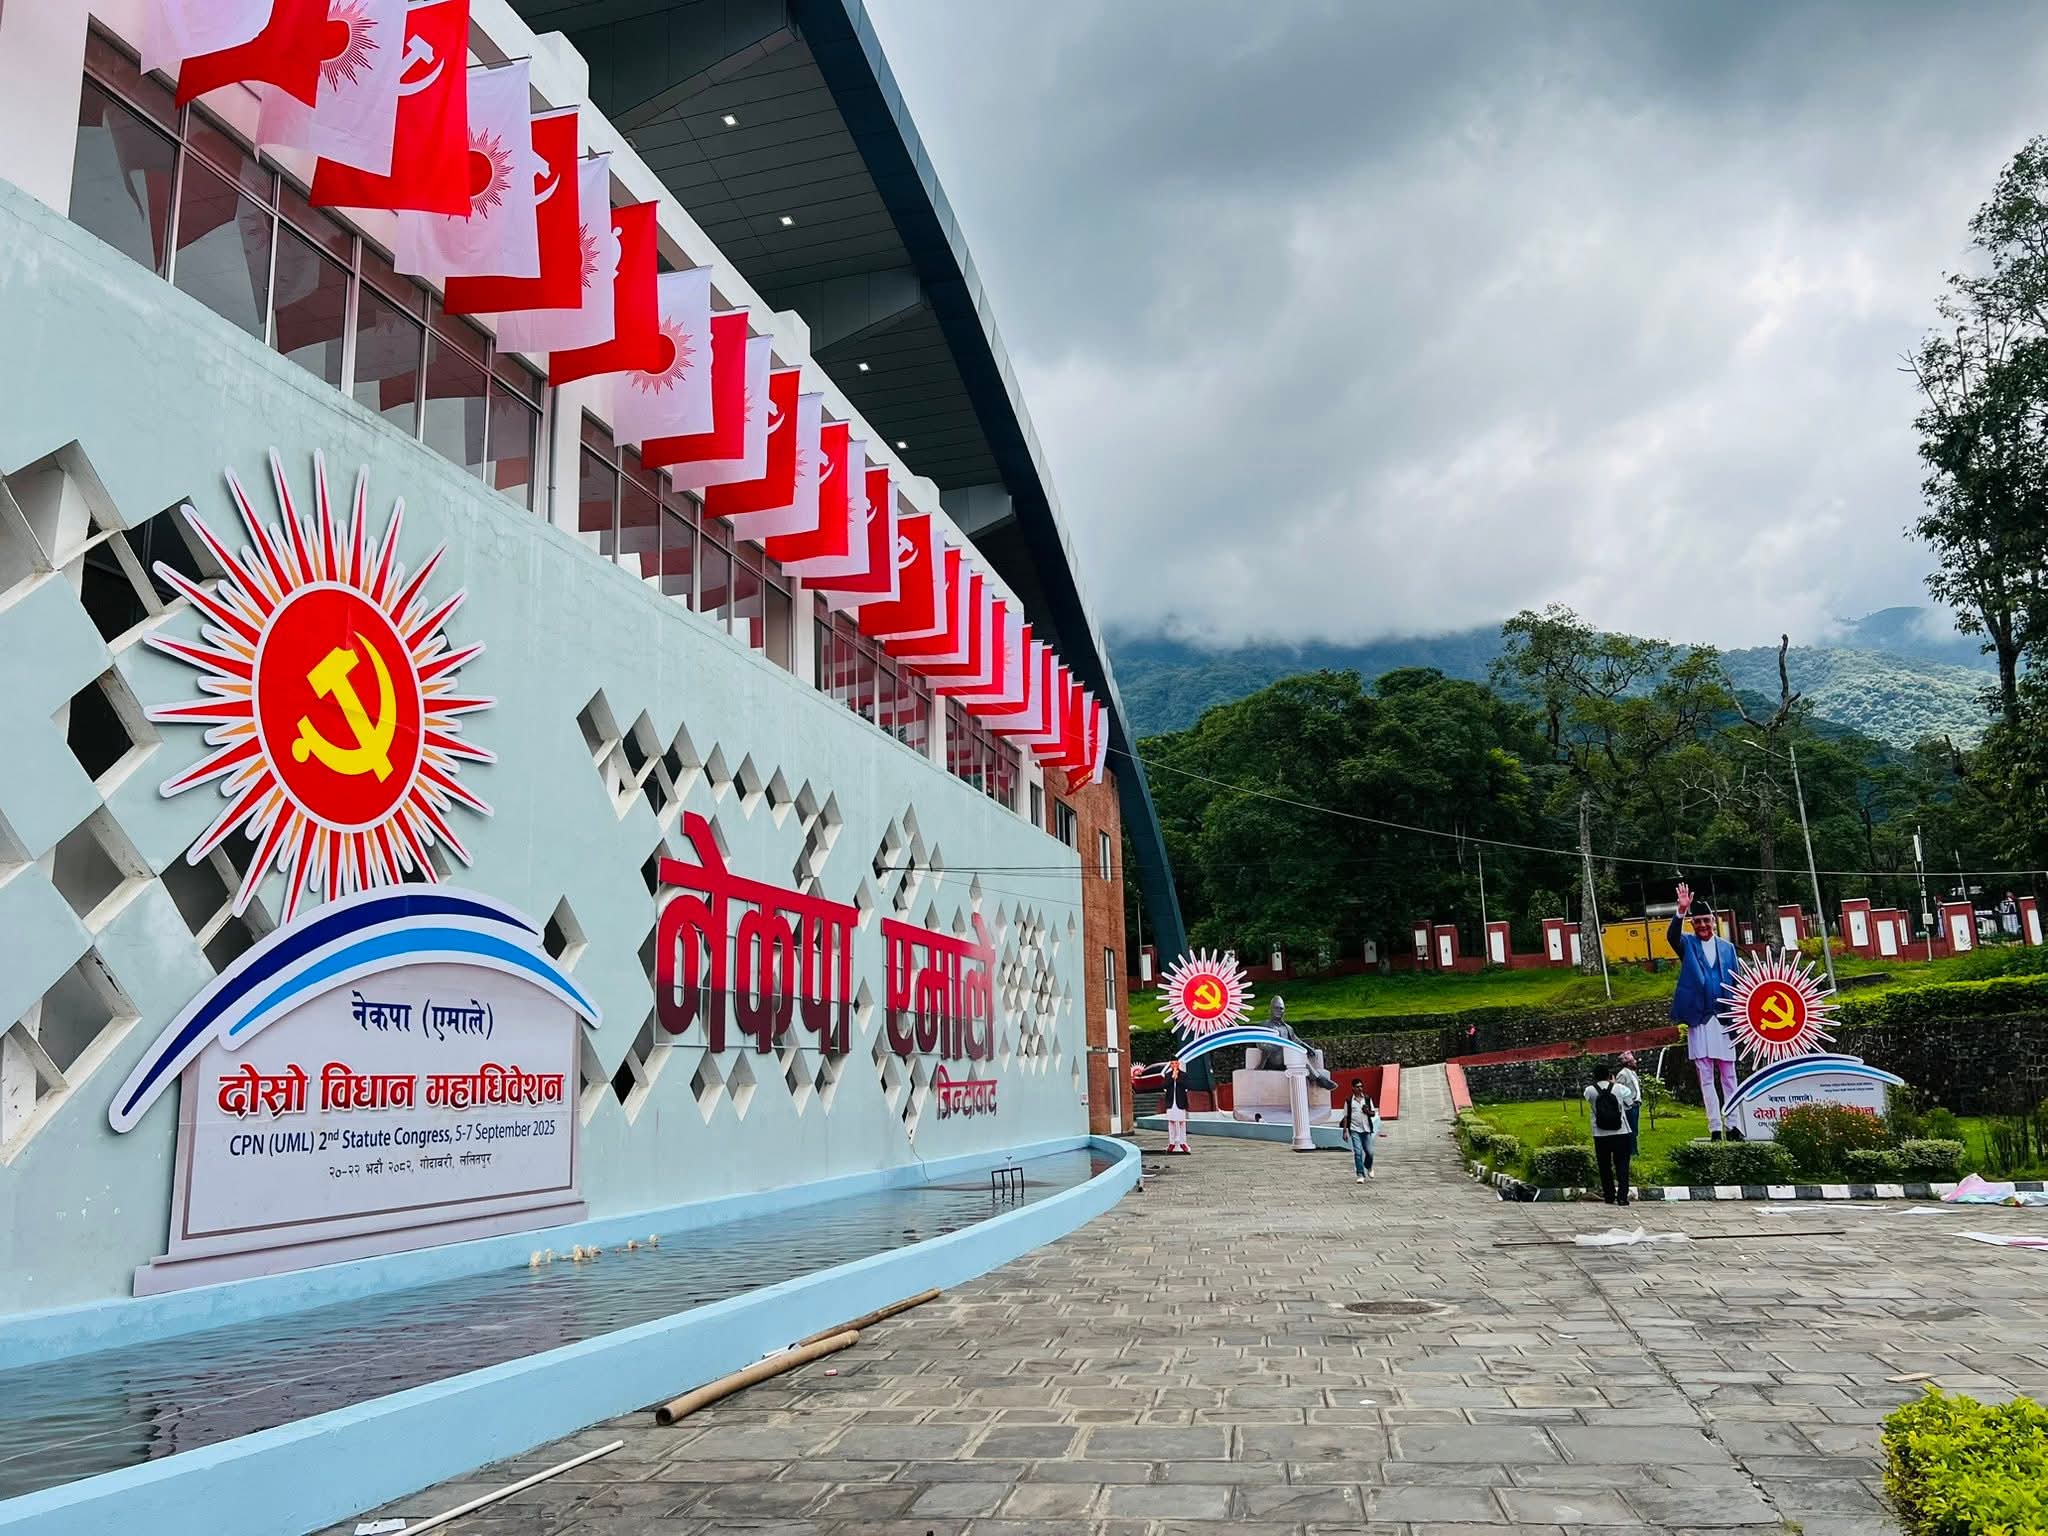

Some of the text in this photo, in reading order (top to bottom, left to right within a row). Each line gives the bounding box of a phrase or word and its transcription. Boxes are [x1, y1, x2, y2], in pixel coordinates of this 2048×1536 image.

[657, 810, 996, 1062] नेकपा एमाले
[352, 990, 493, 1041] नेकपा (एमाले)
[217, 1061, 564, 1118] दोस्रो विधान महाधिवेशन
[229, 1134, 265, 1156] CPN
[269, 1131, 315, 1157] (UML)
[341, 1129, 392, 1149] Statute
[394, 1127, 453, 1149] Congress,
[455, 1124, 473, 1142] 5-7
[475, 1120, 532, 1144] September
[532, 1119, 556, 1136] 2025
[366, 1157, 383, 1175] भदौ
